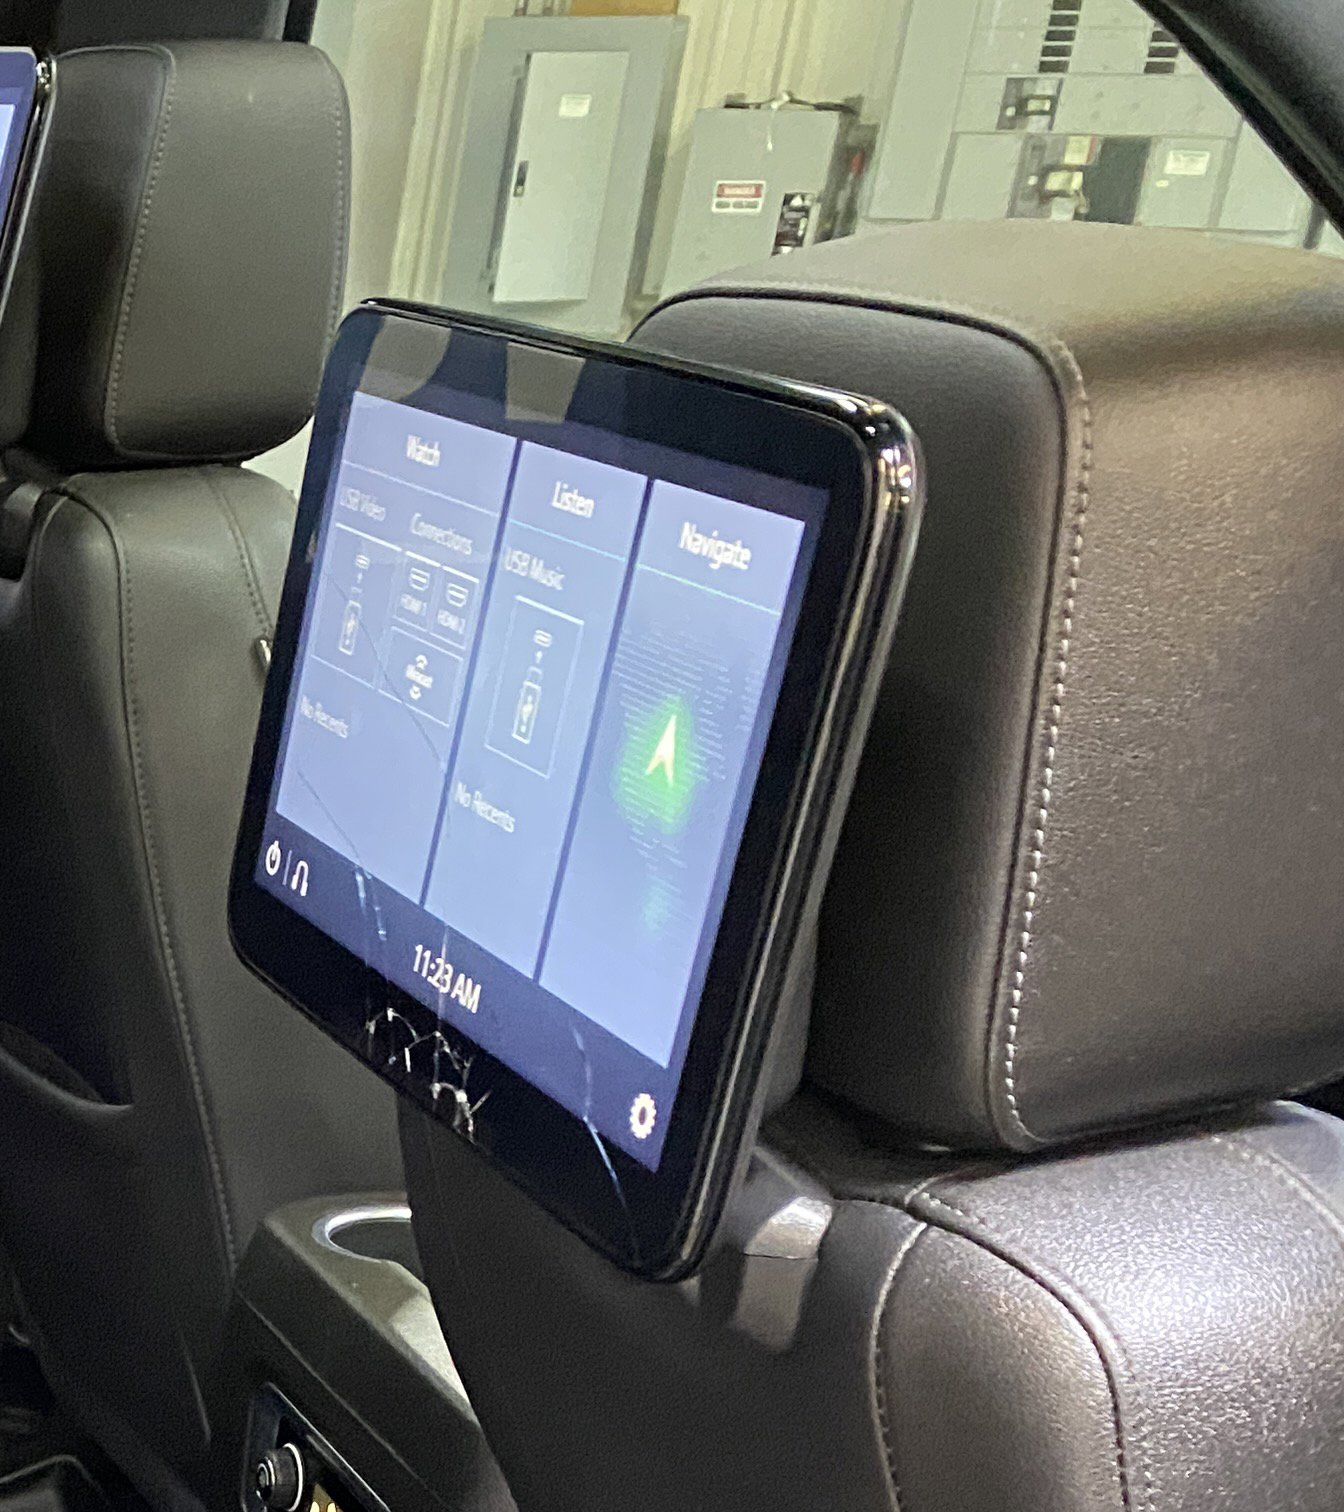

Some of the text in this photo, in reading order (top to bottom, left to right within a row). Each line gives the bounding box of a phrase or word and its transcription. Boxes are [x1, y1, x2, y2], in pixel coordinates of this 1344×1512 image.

[406, 434, 441, 467] Watch
[551, 481, 595, 518] Listen
[410, 512, 473, 555] Connections
[678, 521, 752, 570] Navigate
[504, 547, 565, 591] USB Music
[455, 781, 516, 833] No Recents
[413, 944, 481, 1014] 11:23 AM
